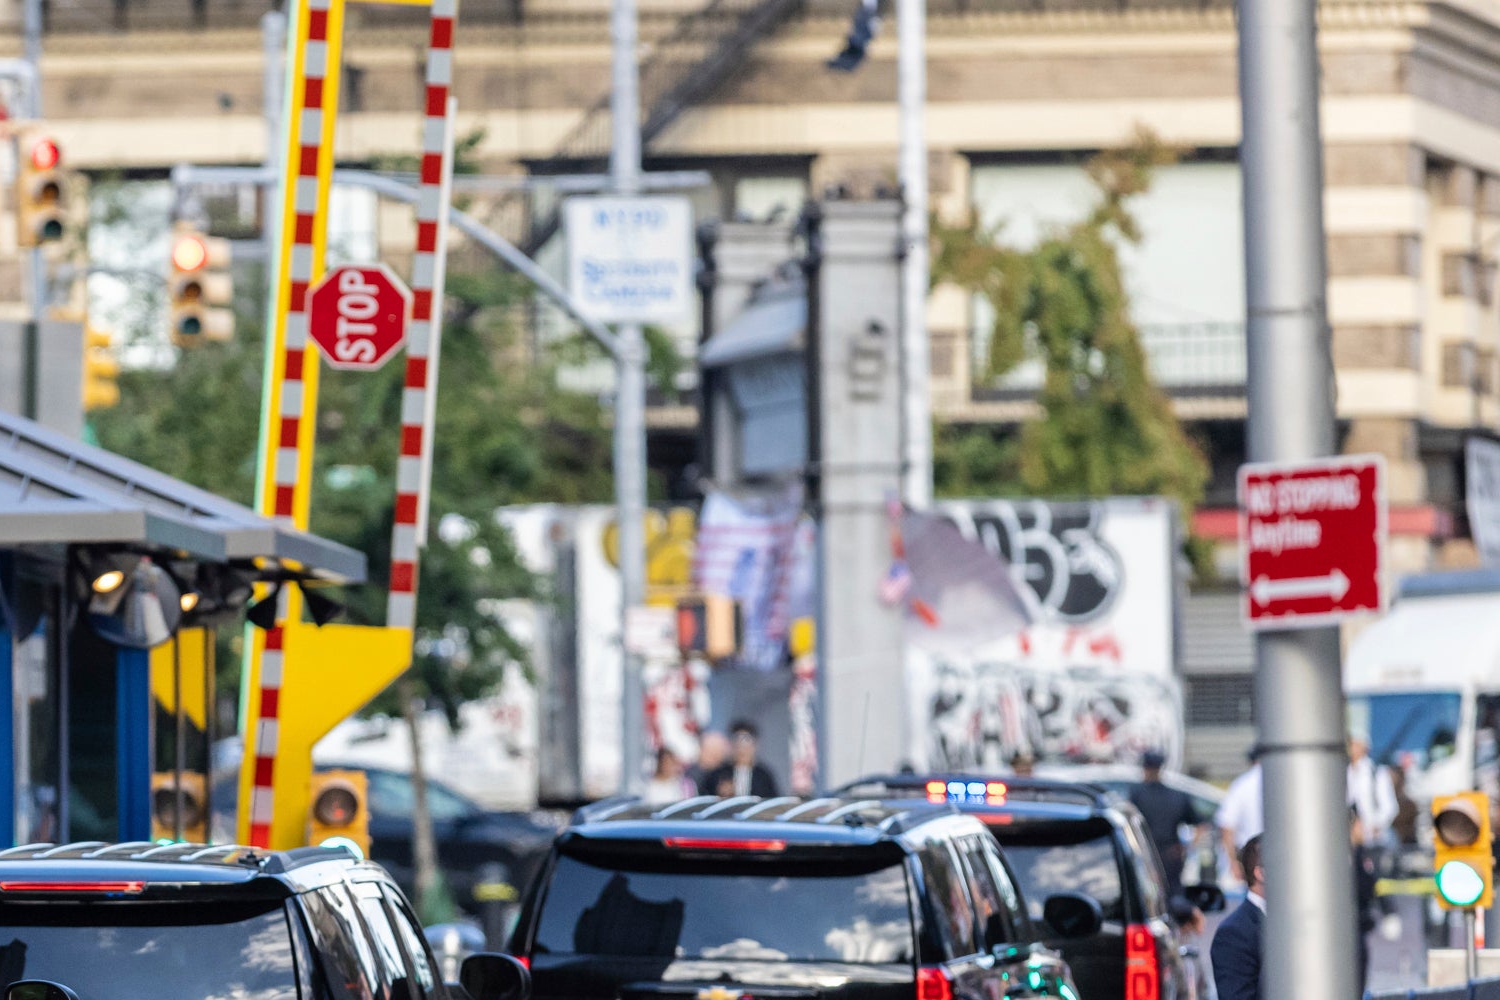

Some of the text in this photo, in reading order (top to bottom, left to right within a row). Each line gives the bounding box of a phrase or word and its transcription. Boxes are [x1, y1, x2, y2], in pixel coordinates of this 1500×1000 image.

[335, 269, 379, 362] STOP
[1249, 473, 1361, 516] NO STOPPING
[1250, 514, 1322, 557] Anytime
